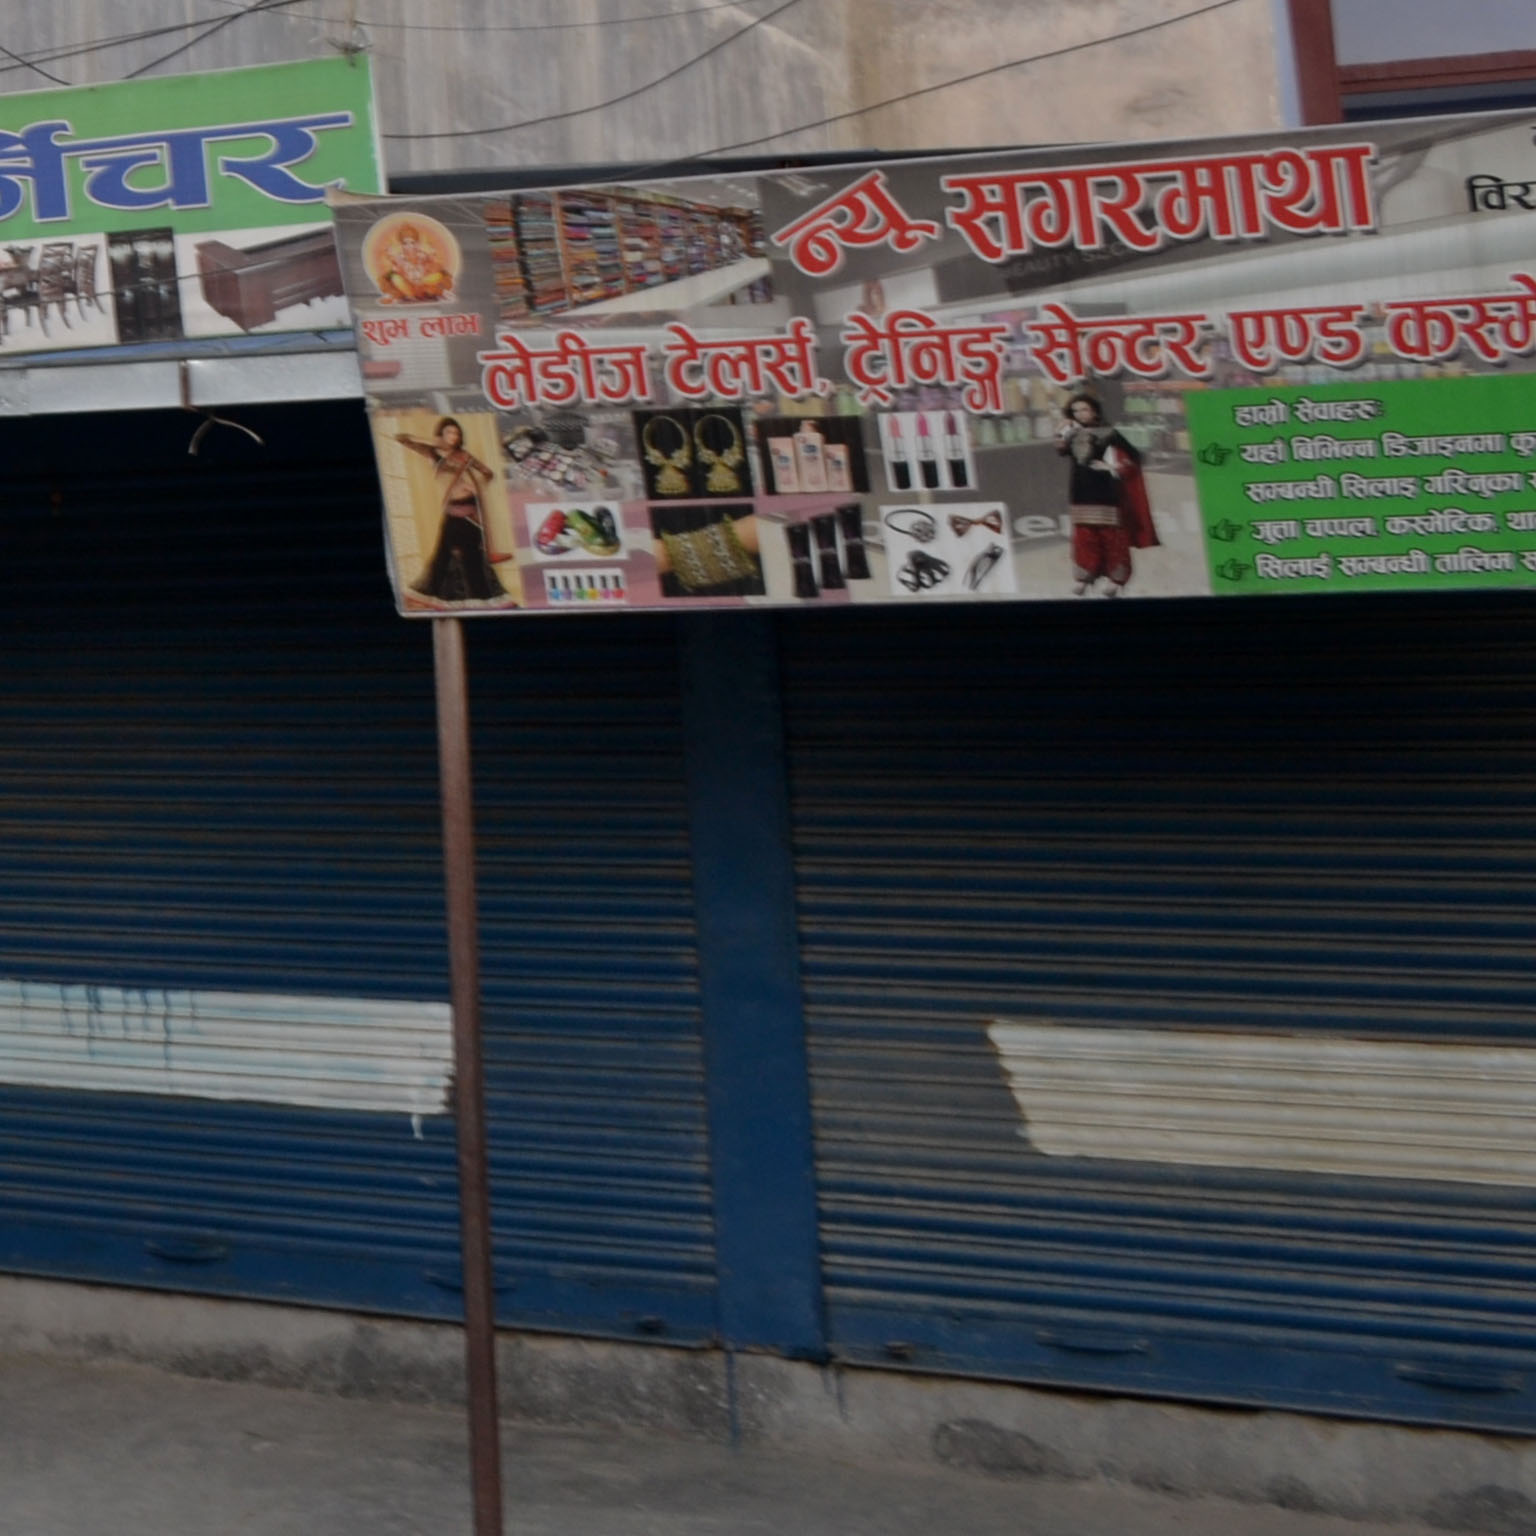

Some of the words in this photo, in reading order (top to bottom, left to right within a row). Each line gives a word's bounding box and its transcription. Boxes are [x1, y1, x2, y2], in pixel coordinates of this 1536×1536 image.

[773, 166, 941, 281] न्यू
[942, 142, 1383, 264] सगरमाथा
[362, 318, 408, 346] शुभ
[418, 314, 479, 338] लाभ
[478, 329, 649, 408] लेडीज
[1027, 302, 1213, 384] सेन्टर
[1228, 302, 1366, 372] एण्ड
[1435, 546, 1516, 573] तालिम
